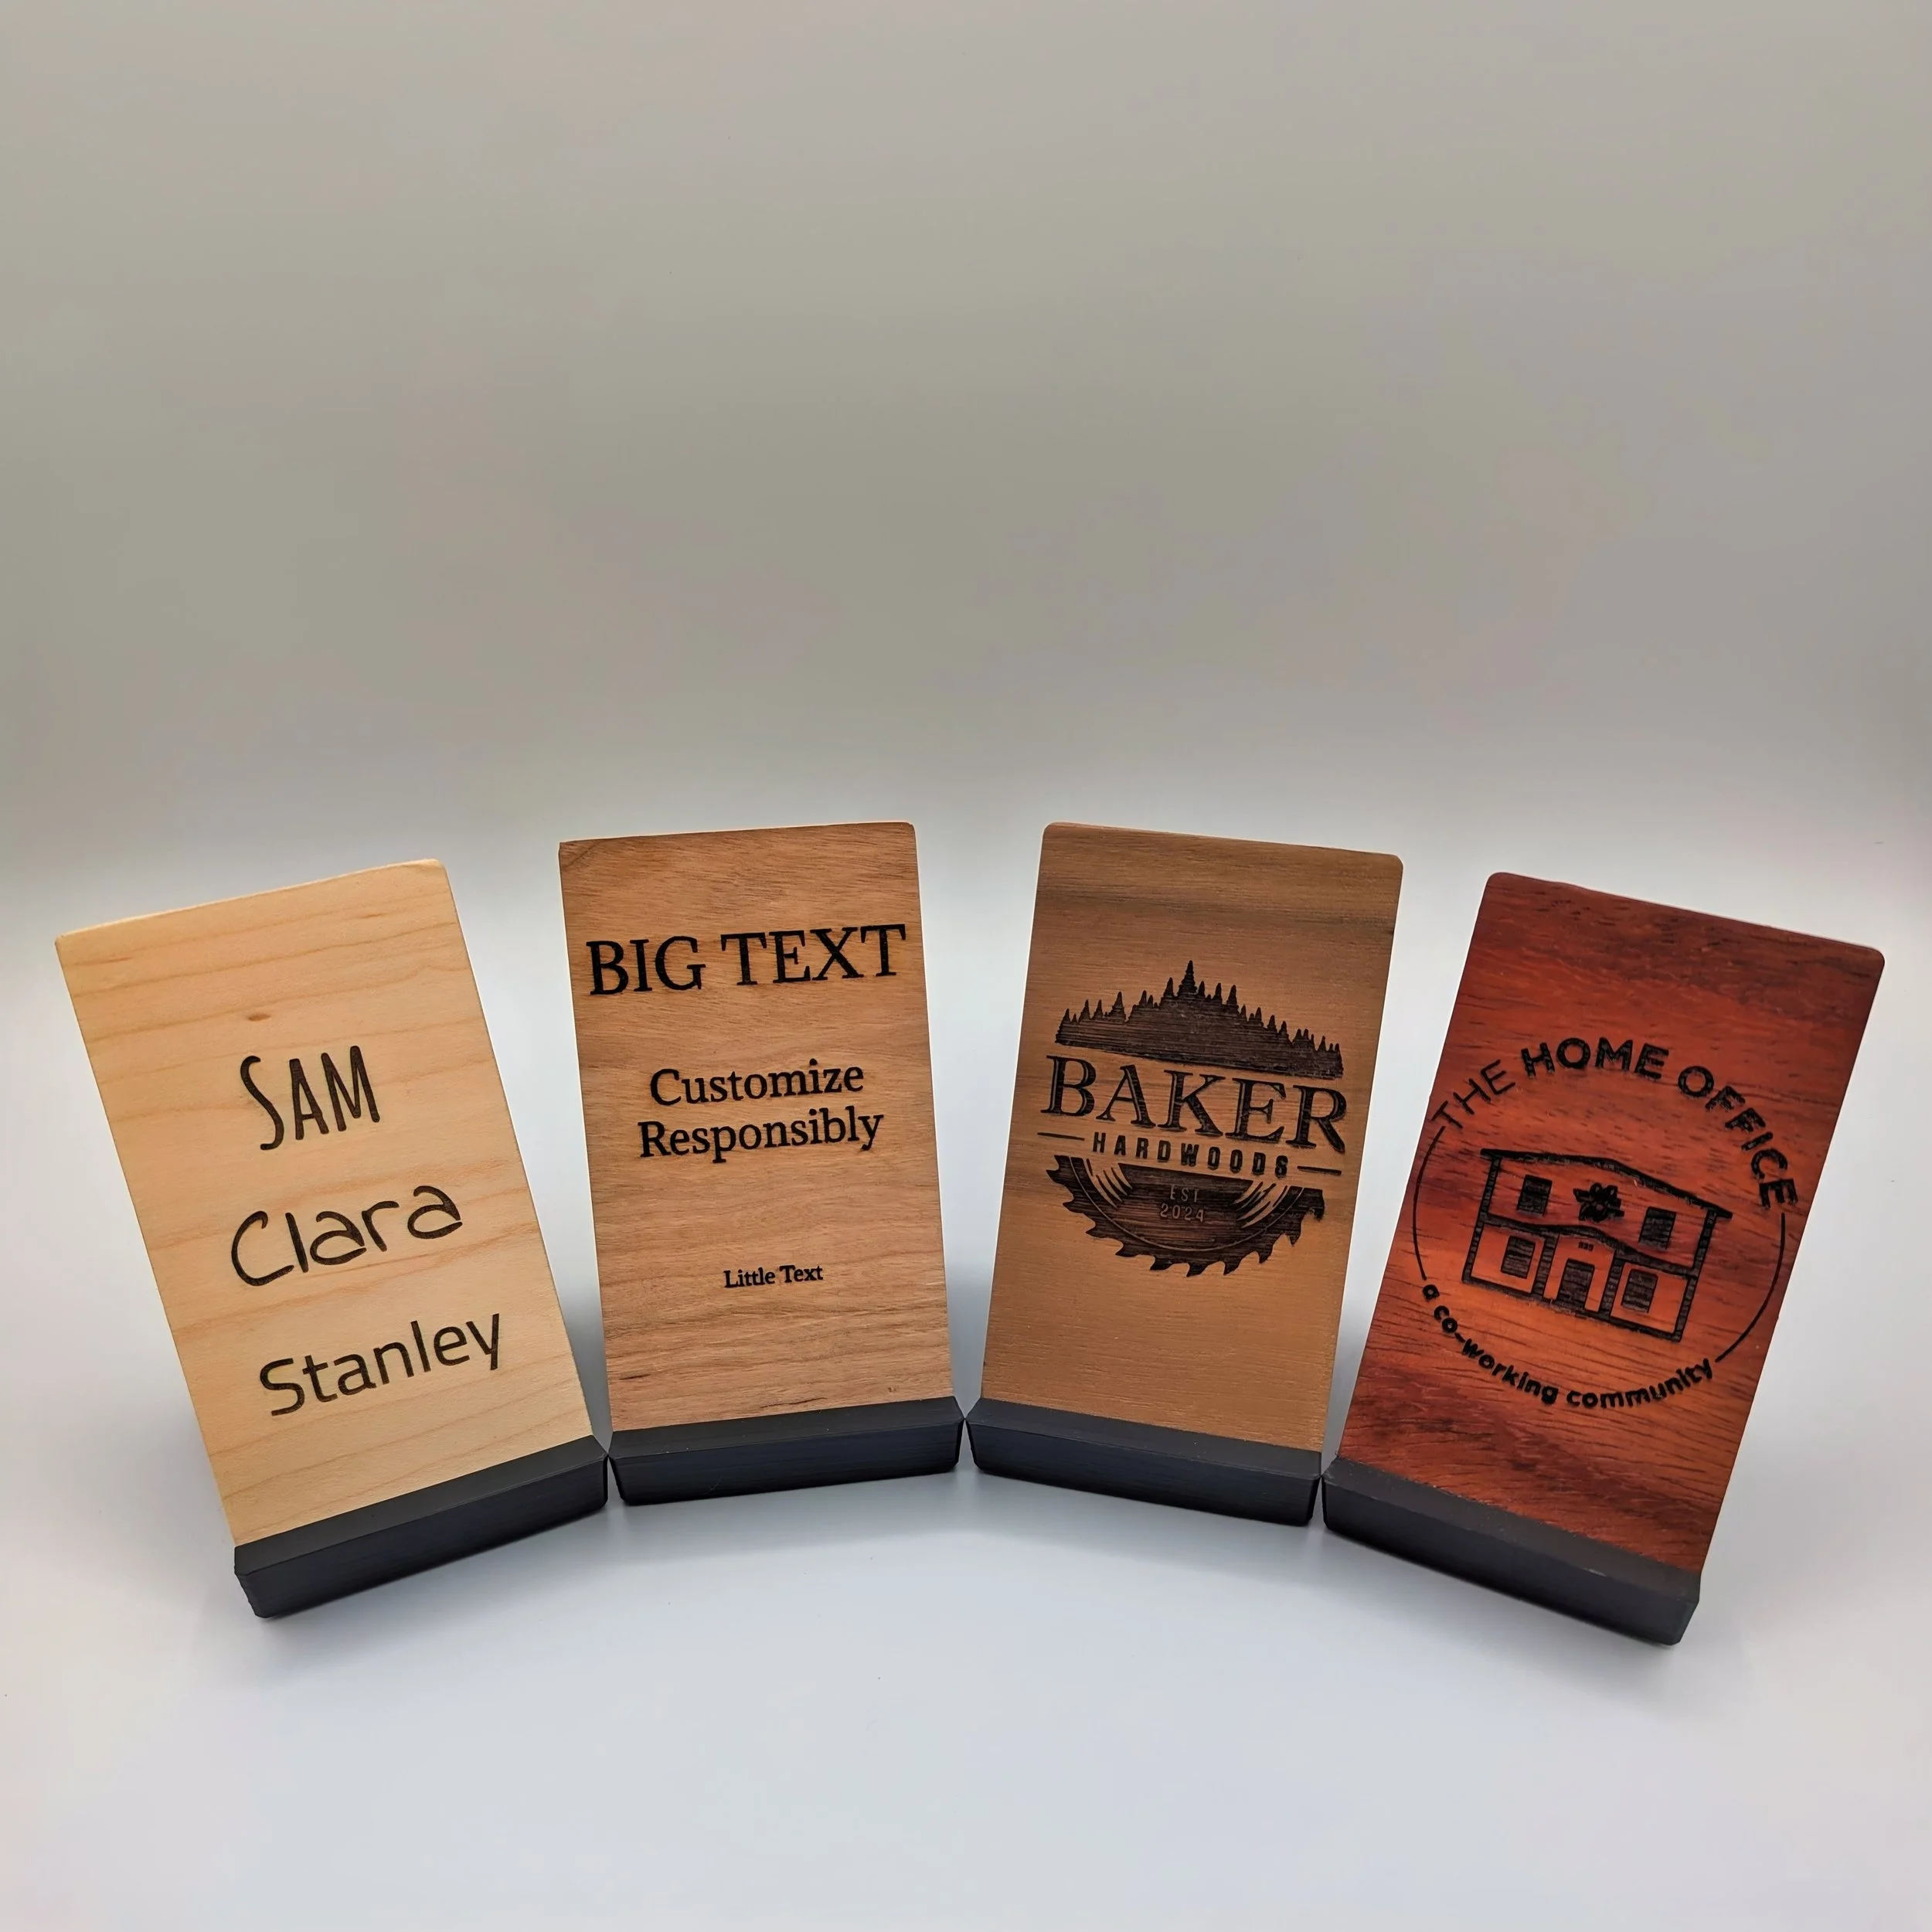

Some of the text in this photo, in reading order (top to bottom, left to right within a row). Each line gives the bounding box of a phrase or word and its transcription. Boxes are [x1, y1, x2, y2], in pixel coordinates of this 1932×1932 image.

[586, 924, 906, 995] BIG TEXT
[240, 1046, 380, 1150] SAM
[650, 1059, 863, 1106] Customize
[1041, 1056, 1347, 1153] BAKER
[638, 1106, 883, 1163] Responsibly
[1093, 1132, 1288, 1177] HARDWOODS
[1430, 1037, 1798, 1209] THE HOME OFFICE
[1160, 1202, 1204, 1223] 2024
[1170, 1185, 1199, 1202] EST
[231, 1185, 462, 1286] Clara
[723, 1264, 823, 1287] Little Text
[260, 1314, 499, 1416] Stanley
[1423, 1284, 1713, 1409] a co-working community
